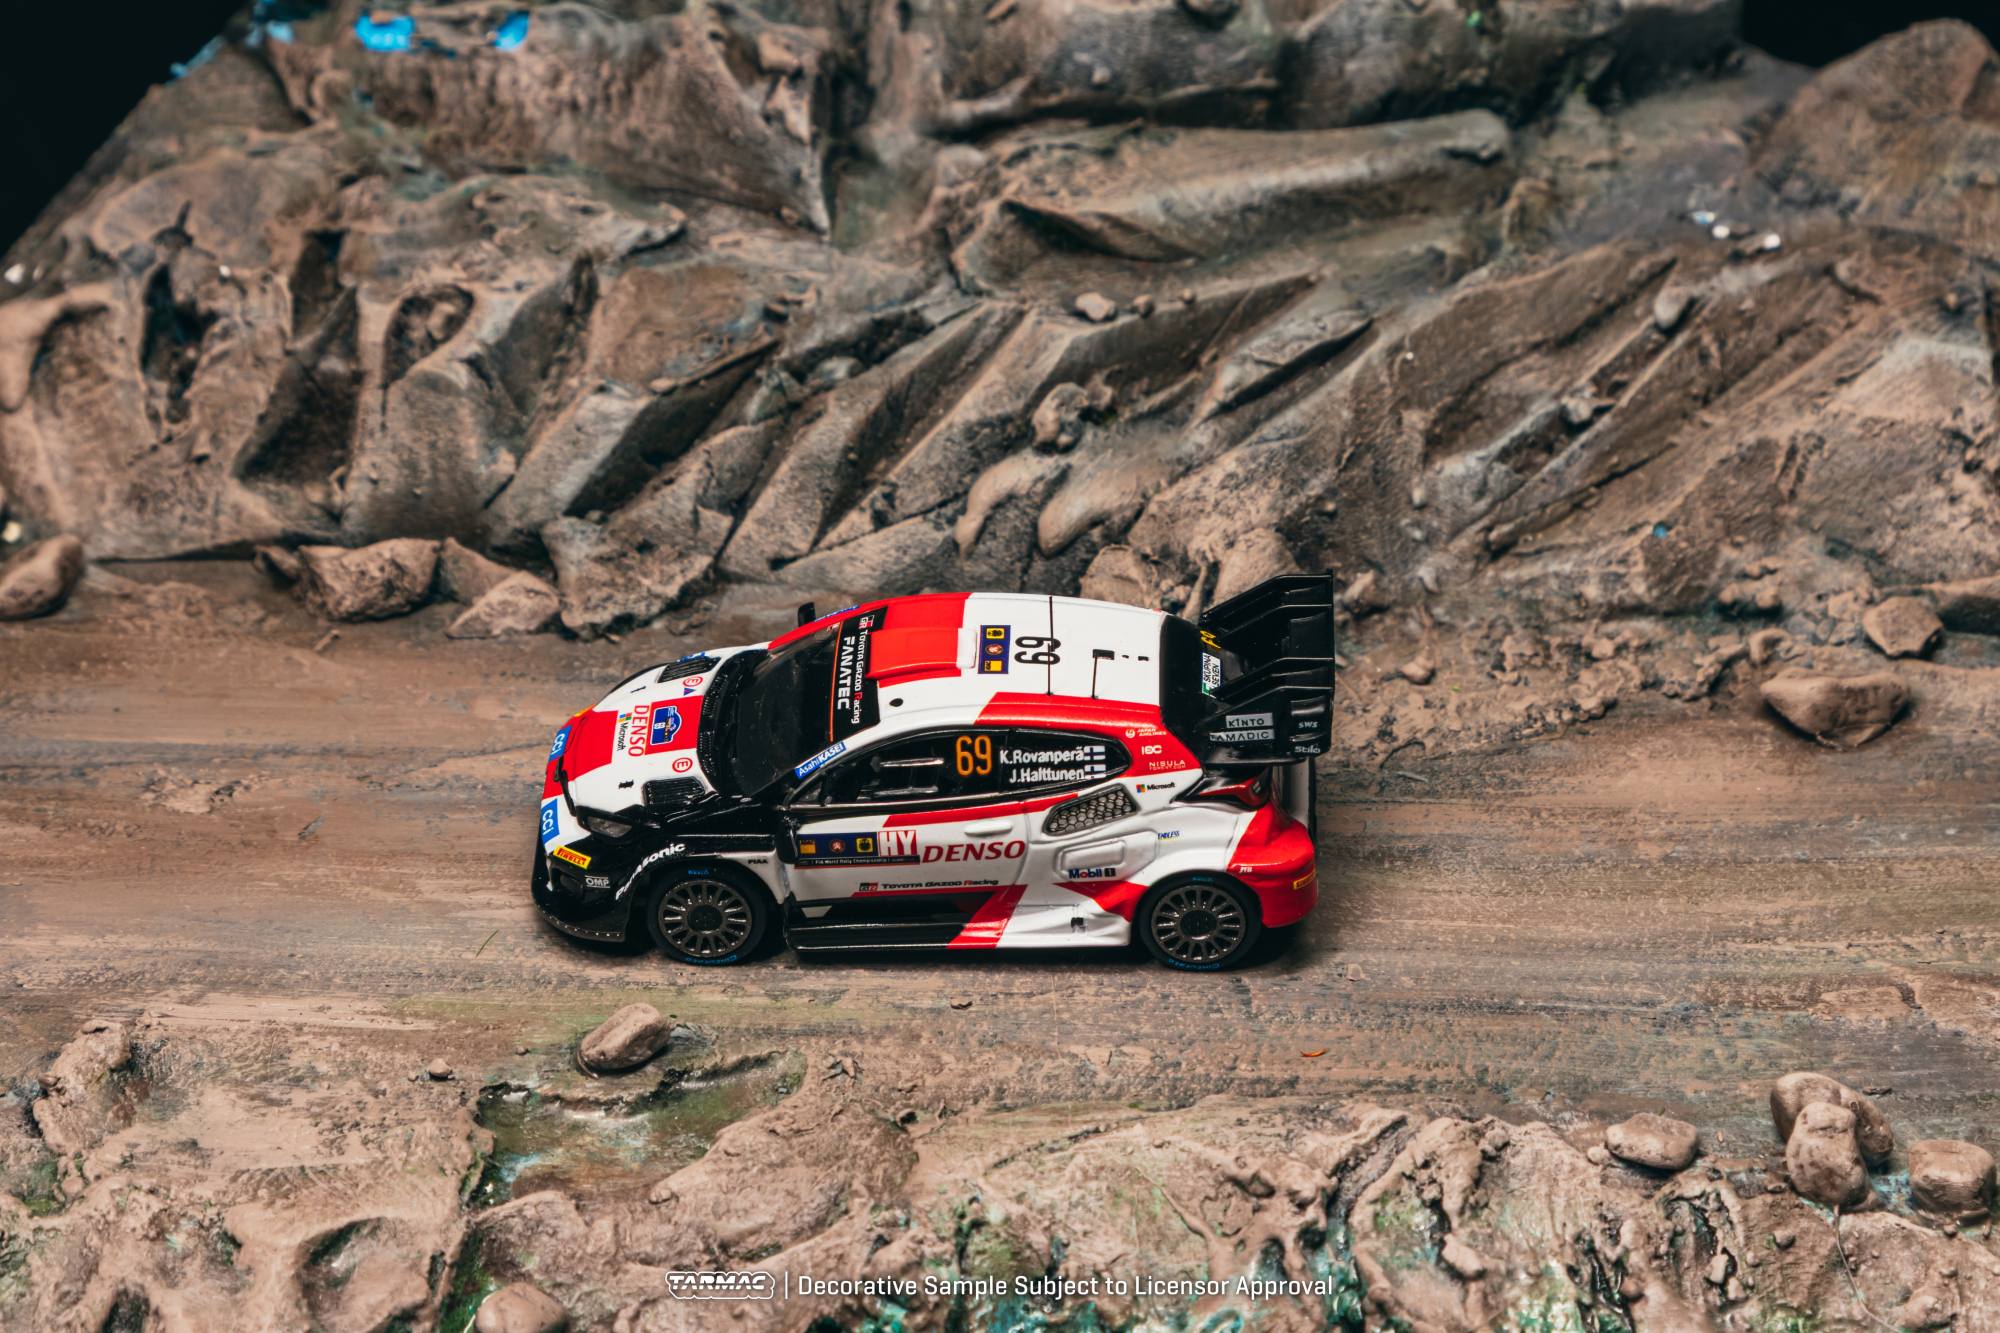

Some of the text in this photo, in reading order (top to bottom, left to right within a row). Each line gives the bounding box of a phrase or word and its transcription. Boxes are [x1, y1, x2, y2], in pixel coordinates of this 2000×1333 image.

[1015, 636, 1061, 665] 69
[837, 636, 856, 710] FANATEC
[854, 661, 864, 692] GAZOO
[628, 705, 650, 757] DENSO
[1228, 717, 1265, 728] KINTO
[955, 735, 992, 778] 69
[1000, 746, 1085, 764] K.Rovanperä
[1009, 767, 1085, 783] J.Halttunen
[880, 830, 917, 857] HY
[922, 840, 1026, 863] DENSO
[585, 877, 610, 886] OMP
[1068, 868, 1103, 879] Mobil
